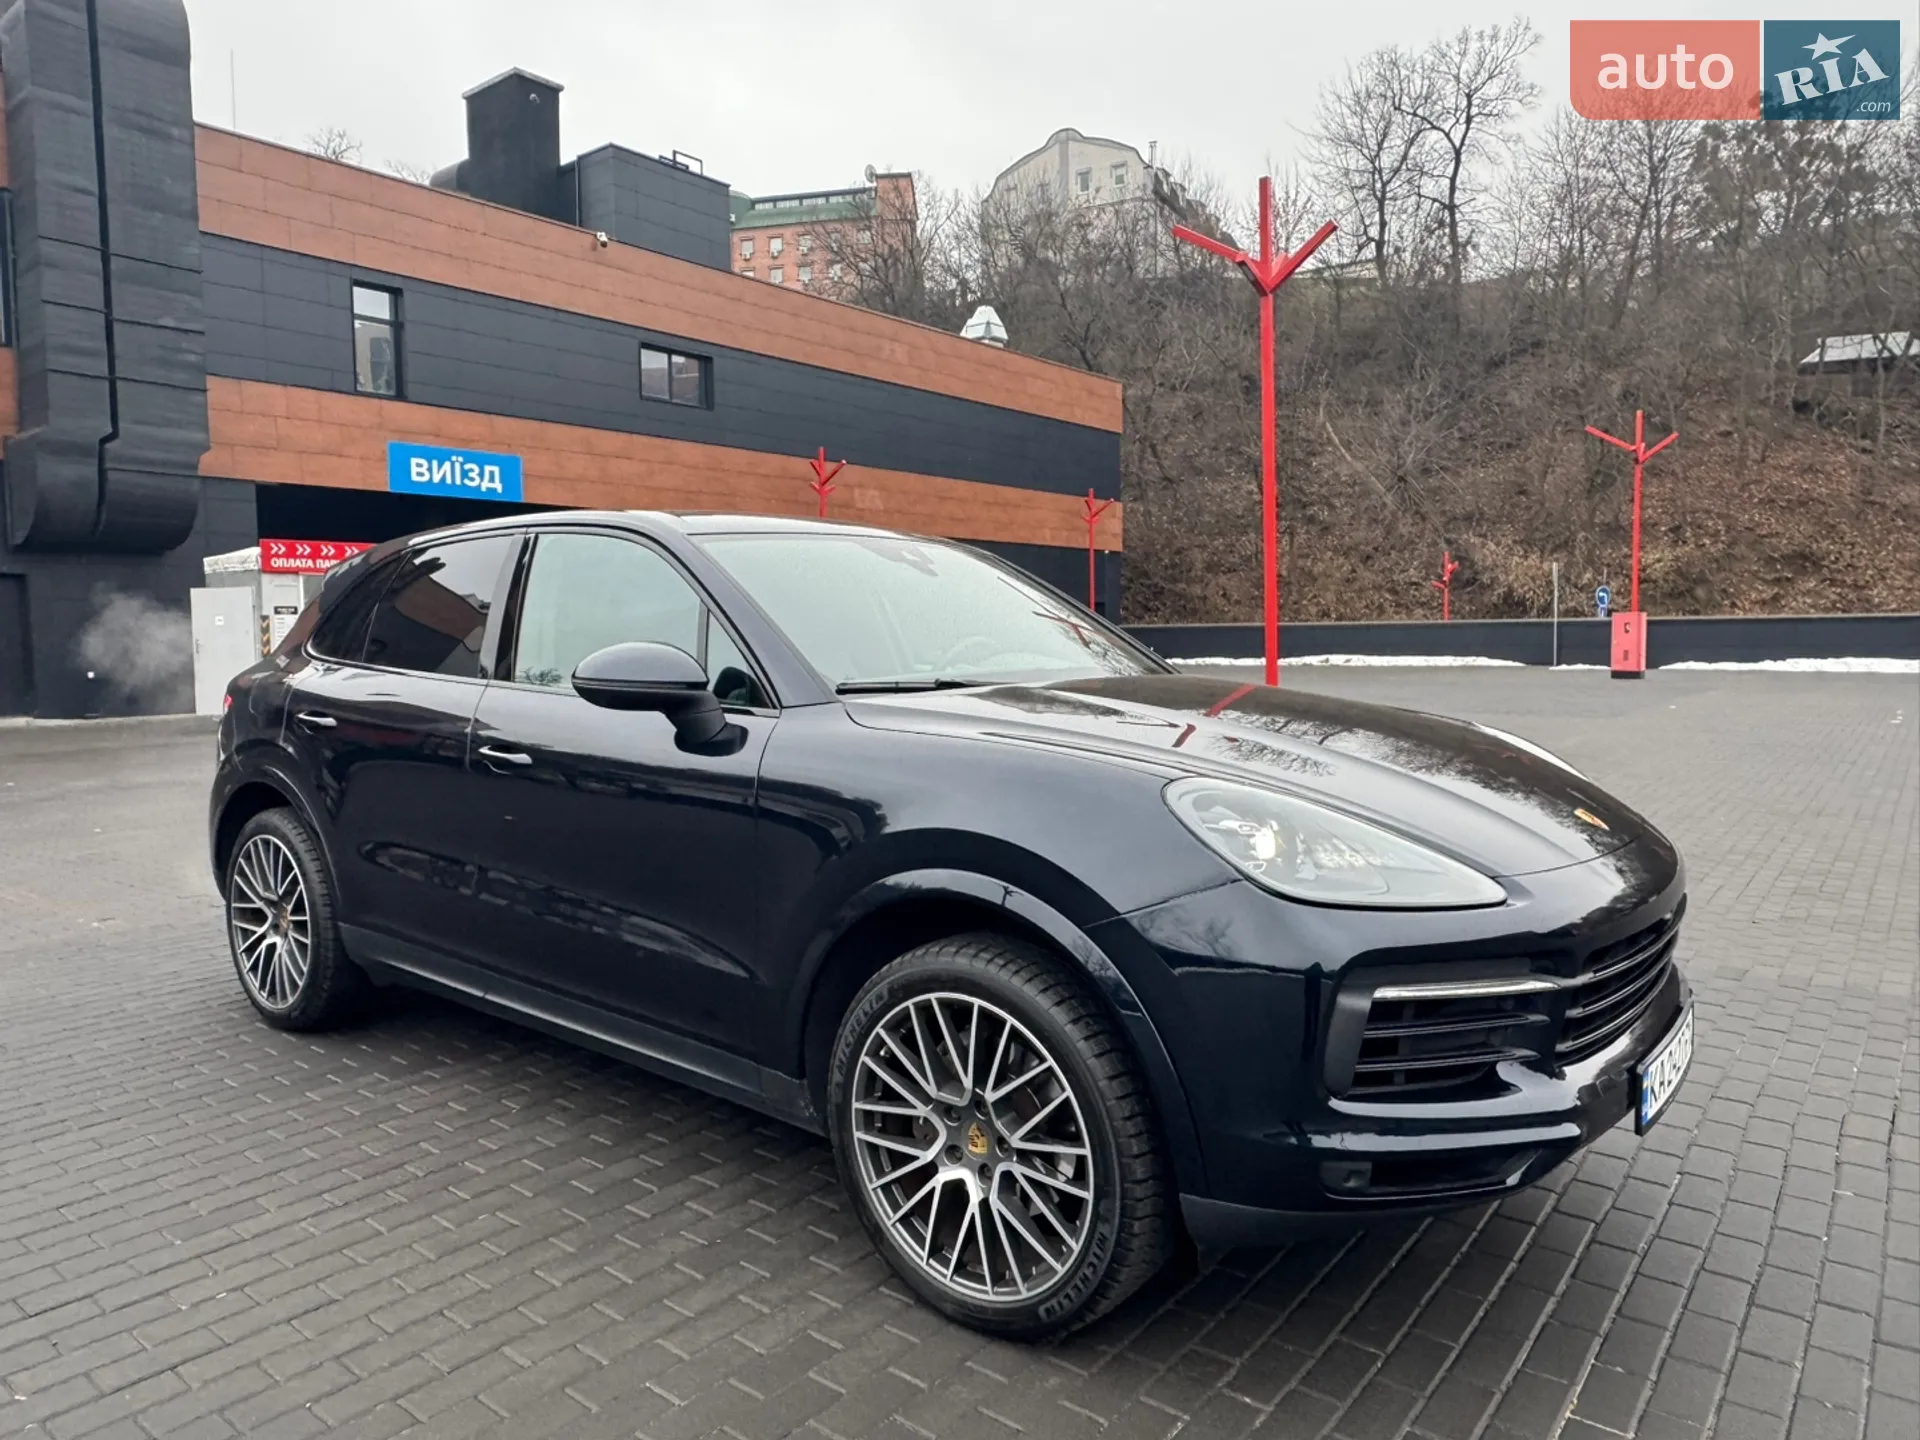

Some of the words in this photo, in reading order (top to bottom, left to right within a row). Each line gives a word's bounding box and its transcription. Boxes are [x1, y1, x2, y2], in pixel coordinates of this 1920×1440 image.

[410, 455, 503, 494] ВИЇЗД
[270, 557, 314, 569] ОПЛАТА
[1038, 1229, 1109, 1319] MICHELIN
